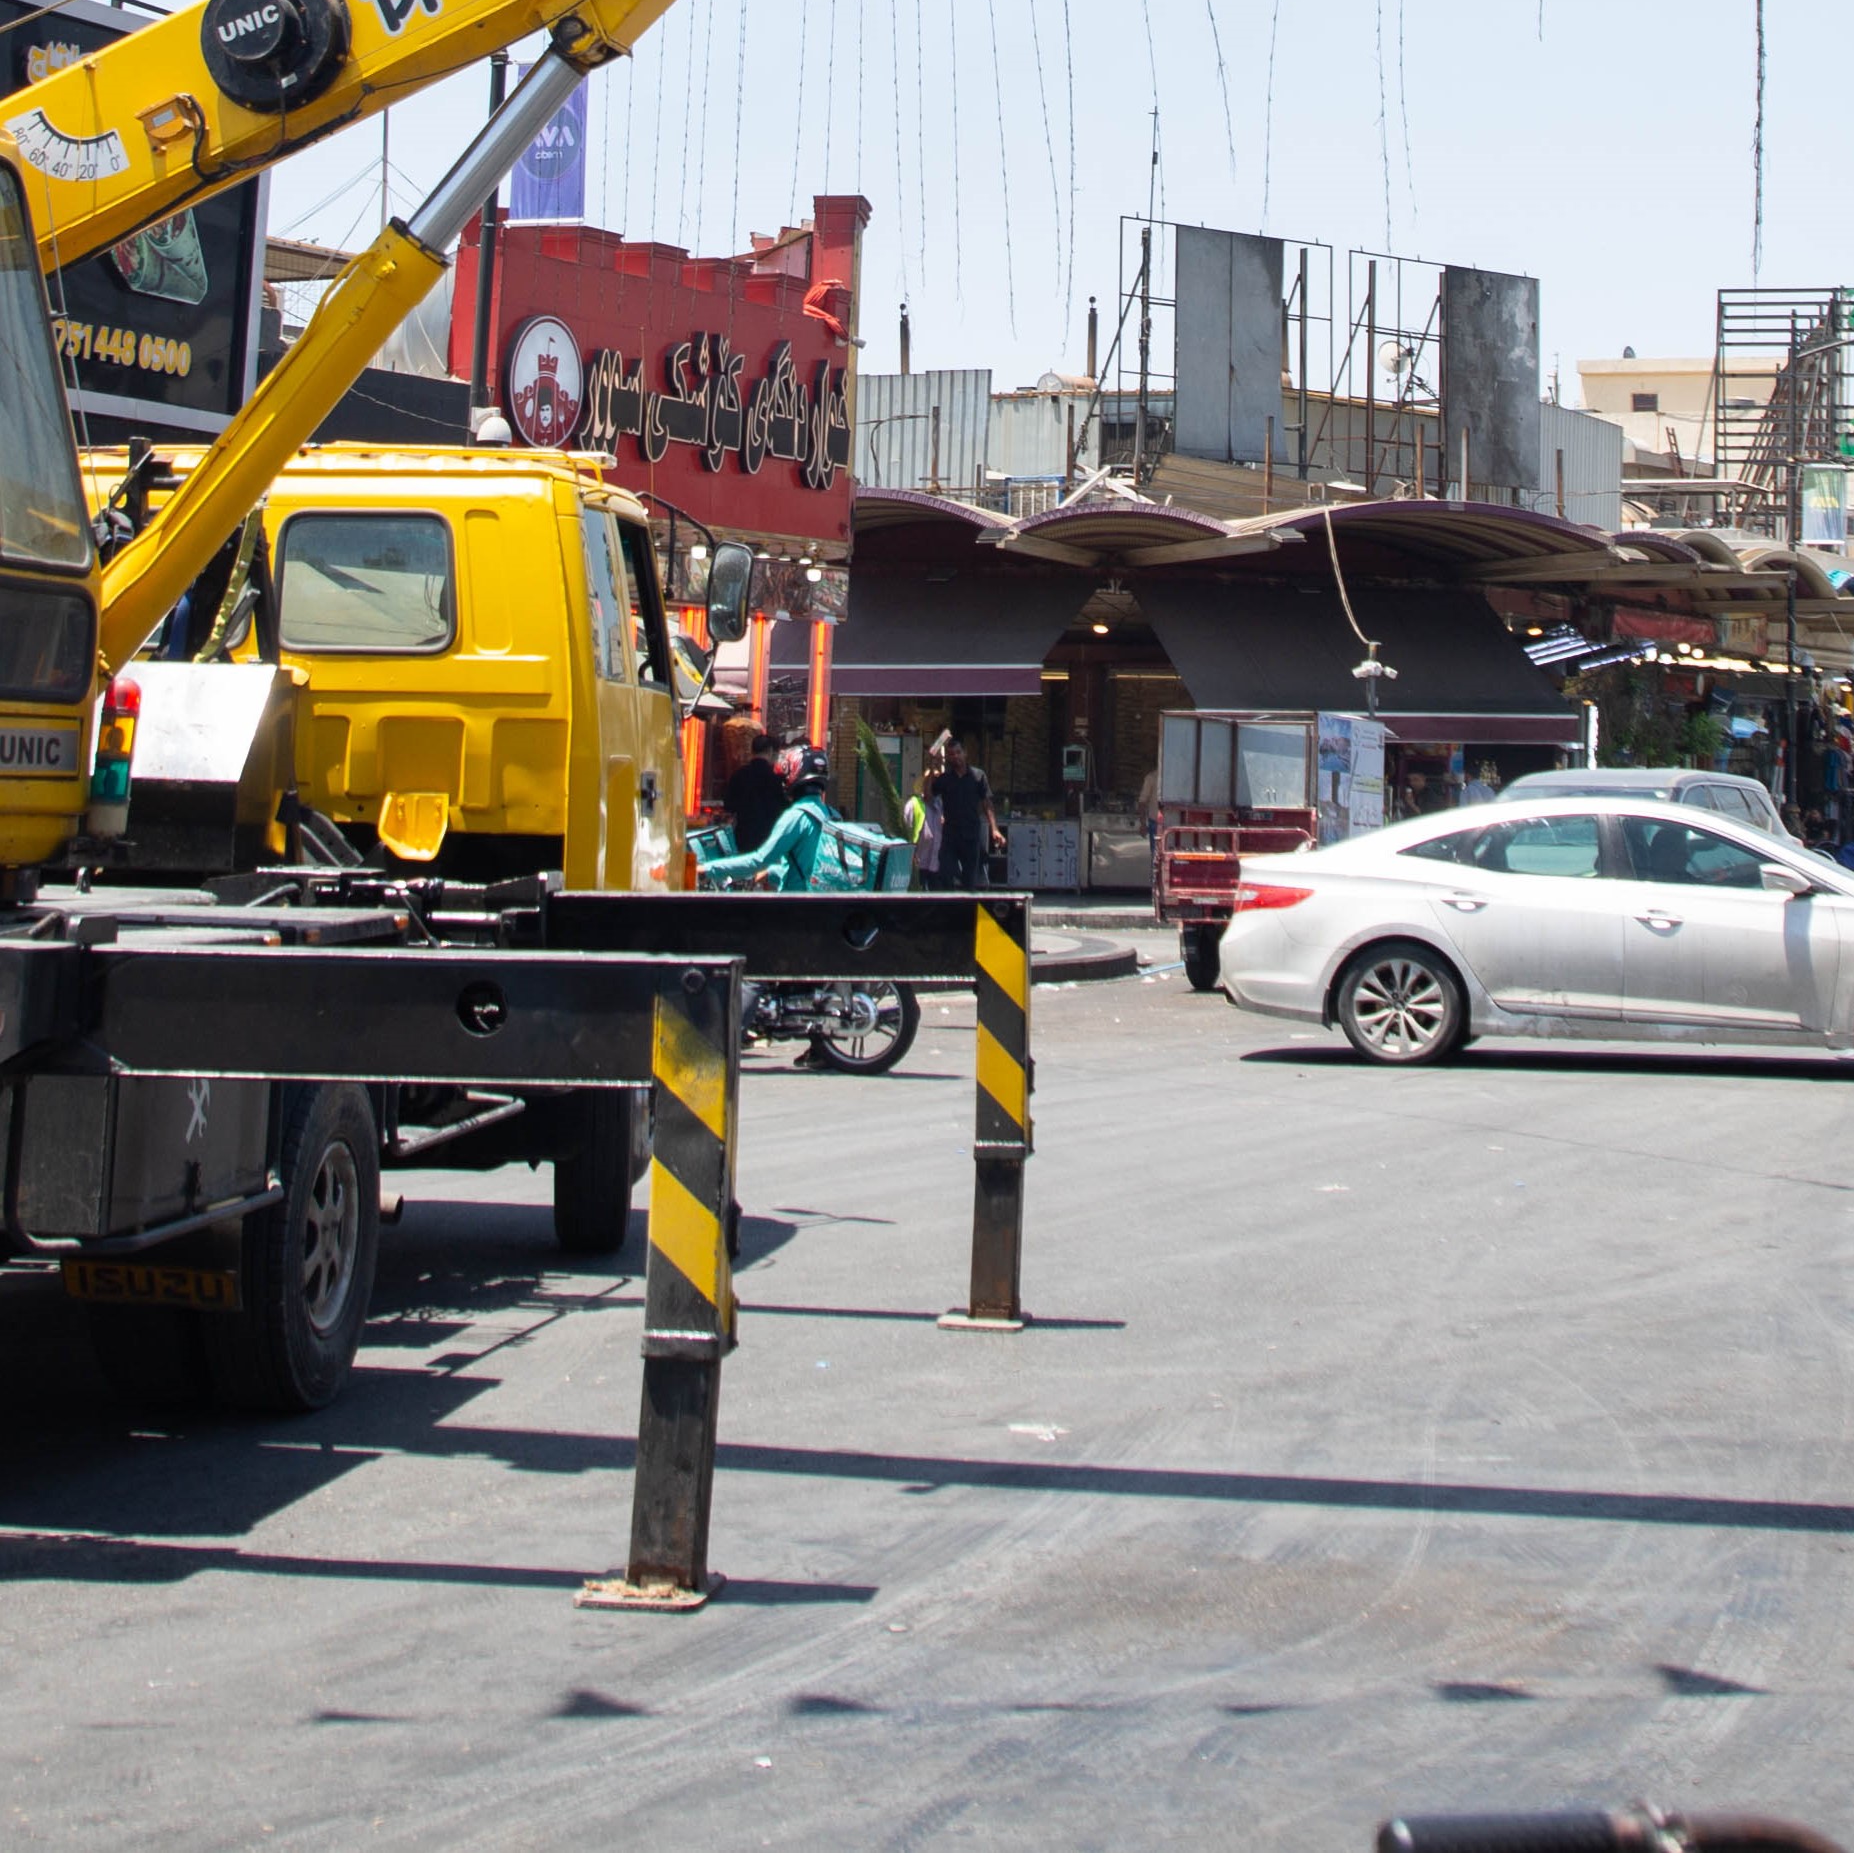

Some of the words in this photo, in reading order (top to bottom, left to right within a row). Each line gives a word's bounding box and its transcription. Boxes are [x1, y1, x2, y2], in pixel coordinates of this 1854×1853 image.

[217, 4, 280, 43] UNIC
[0, 734, 61, 766] UNIC
[79, 1264, 226, 1306] ISUZU
